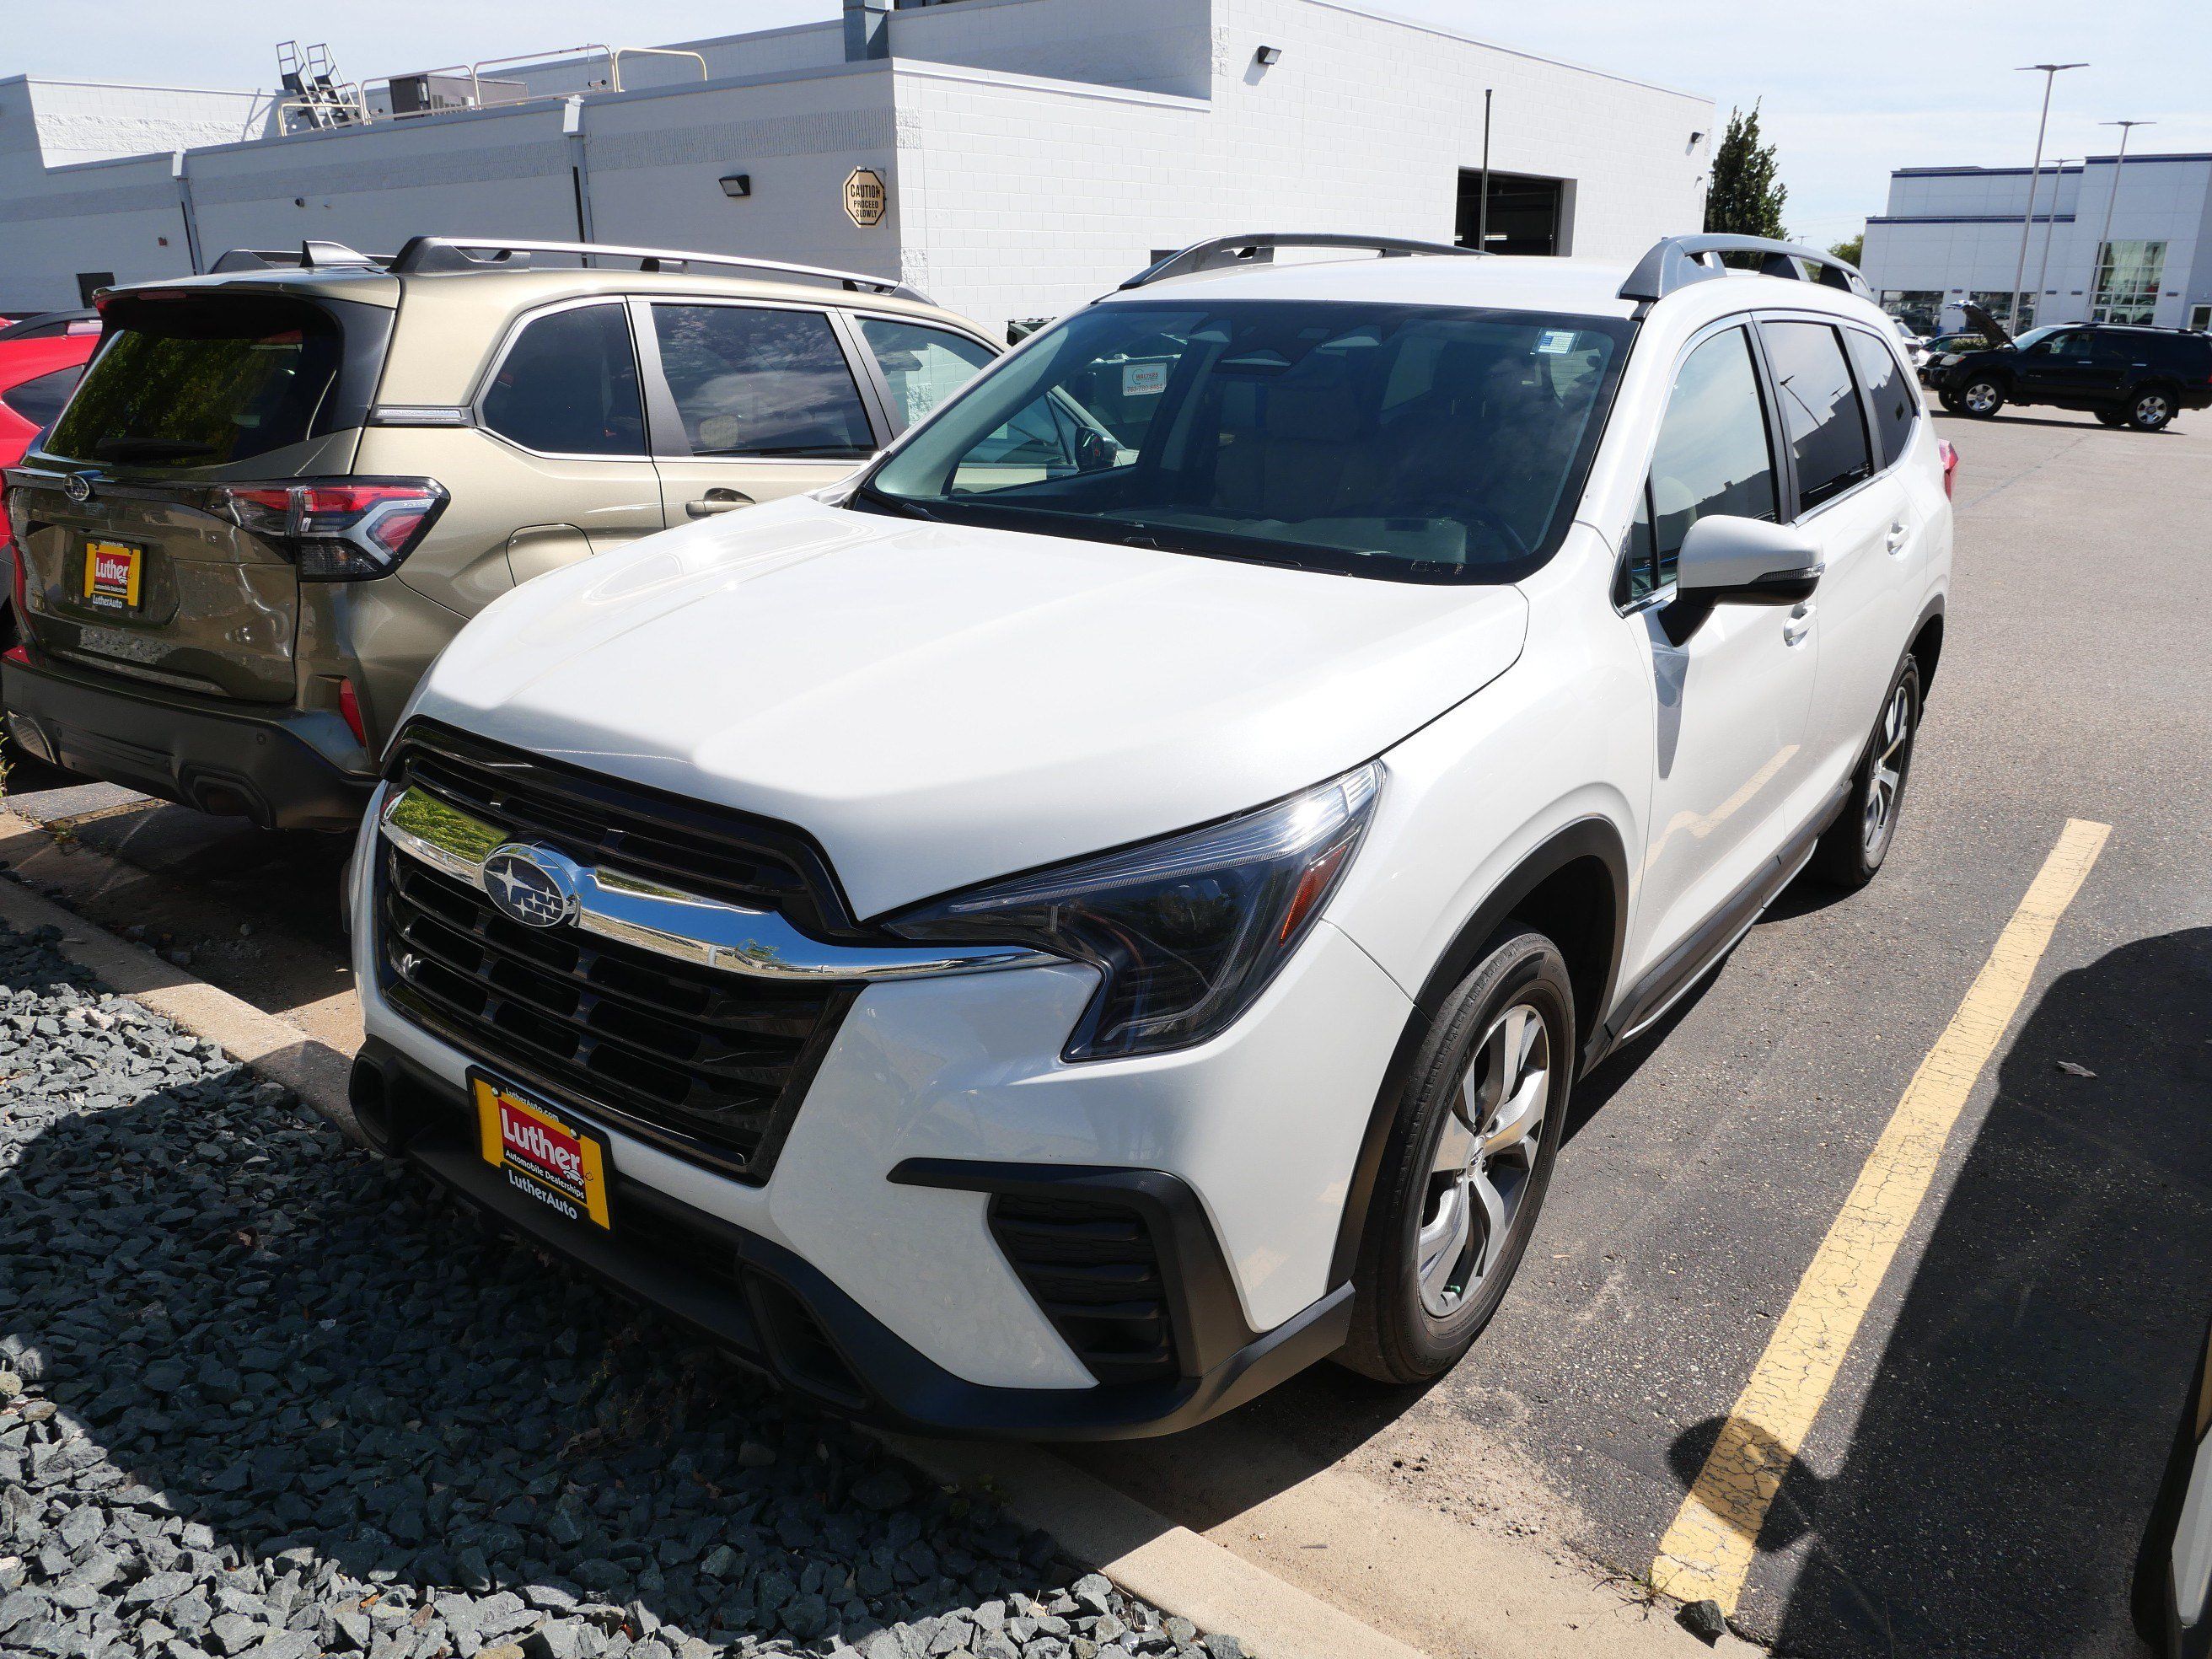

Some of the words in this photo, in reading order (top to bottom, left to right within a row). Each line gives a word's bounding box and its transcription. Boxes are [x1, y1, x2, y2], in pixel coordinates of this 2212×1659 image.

[851, 184, 881, 198] CAUTION
[856, 209, 877, 217] SLOWLY
[95, 557, 128, 579] Luther
[93, 594, 122, 608] LutherAuto
[506, 1087, 560, 1123] LutherAuto.com
[501, 1108, 581, 1171] Luther
[505, 1149, 544, 1177] Automobile
[545, 1169, 585, 1200] Dealerships
[508, 1169, 578, 1221] LutherAuto
